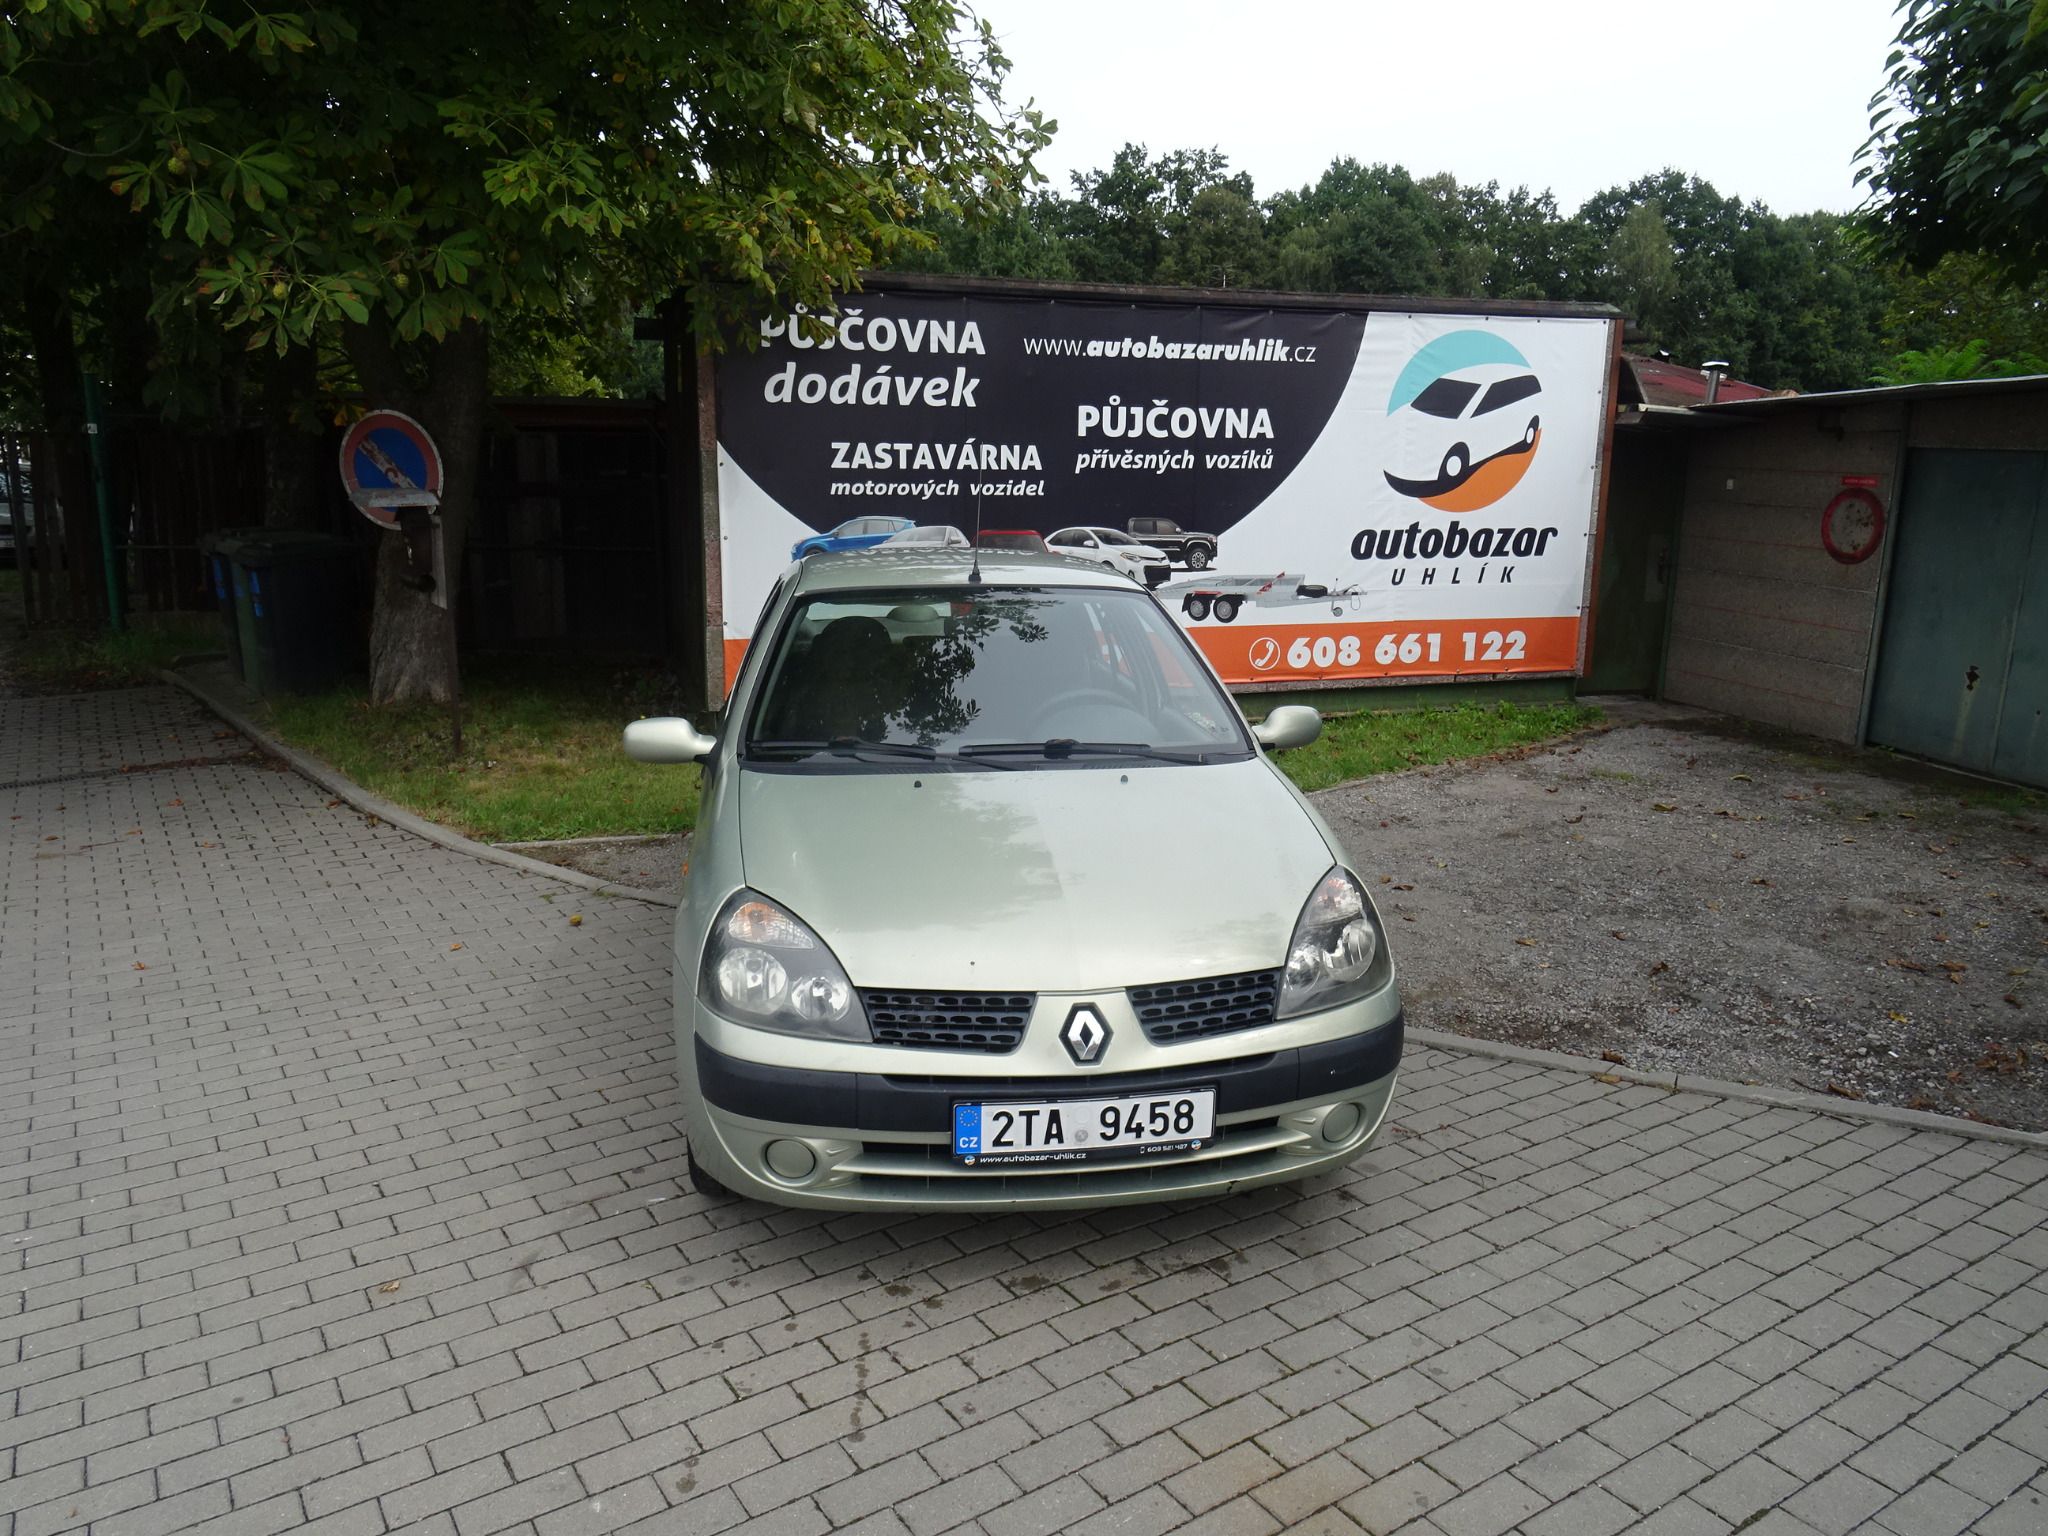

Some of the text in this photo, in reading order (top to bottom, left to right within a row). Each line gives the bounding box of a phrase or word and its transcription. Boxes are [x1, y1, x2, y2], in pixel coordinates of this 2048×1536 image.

[761, 302, 986, 355] PŮJČOVNA
[1023, 336, 1317, 363] www.autobazaruhlik.cz
[764, 361, 981, 407] dodávek
[1077, 395, 1275, 439] PŮJČOVNA
[830, 437, 1043, 471] ZASTAVÁRNA
[1075, 448, 1274, 475] přívěsných vozíků
[830, 479, 1045, 501] motorových vozidel
[1350, 521, 1558, 560] autobazar
[1286, 630, 1527, 669] 608 661 122
[992, 1098, 1195, 1148] 2TA 9458
[959, 1137, 979, 1149] CZ
